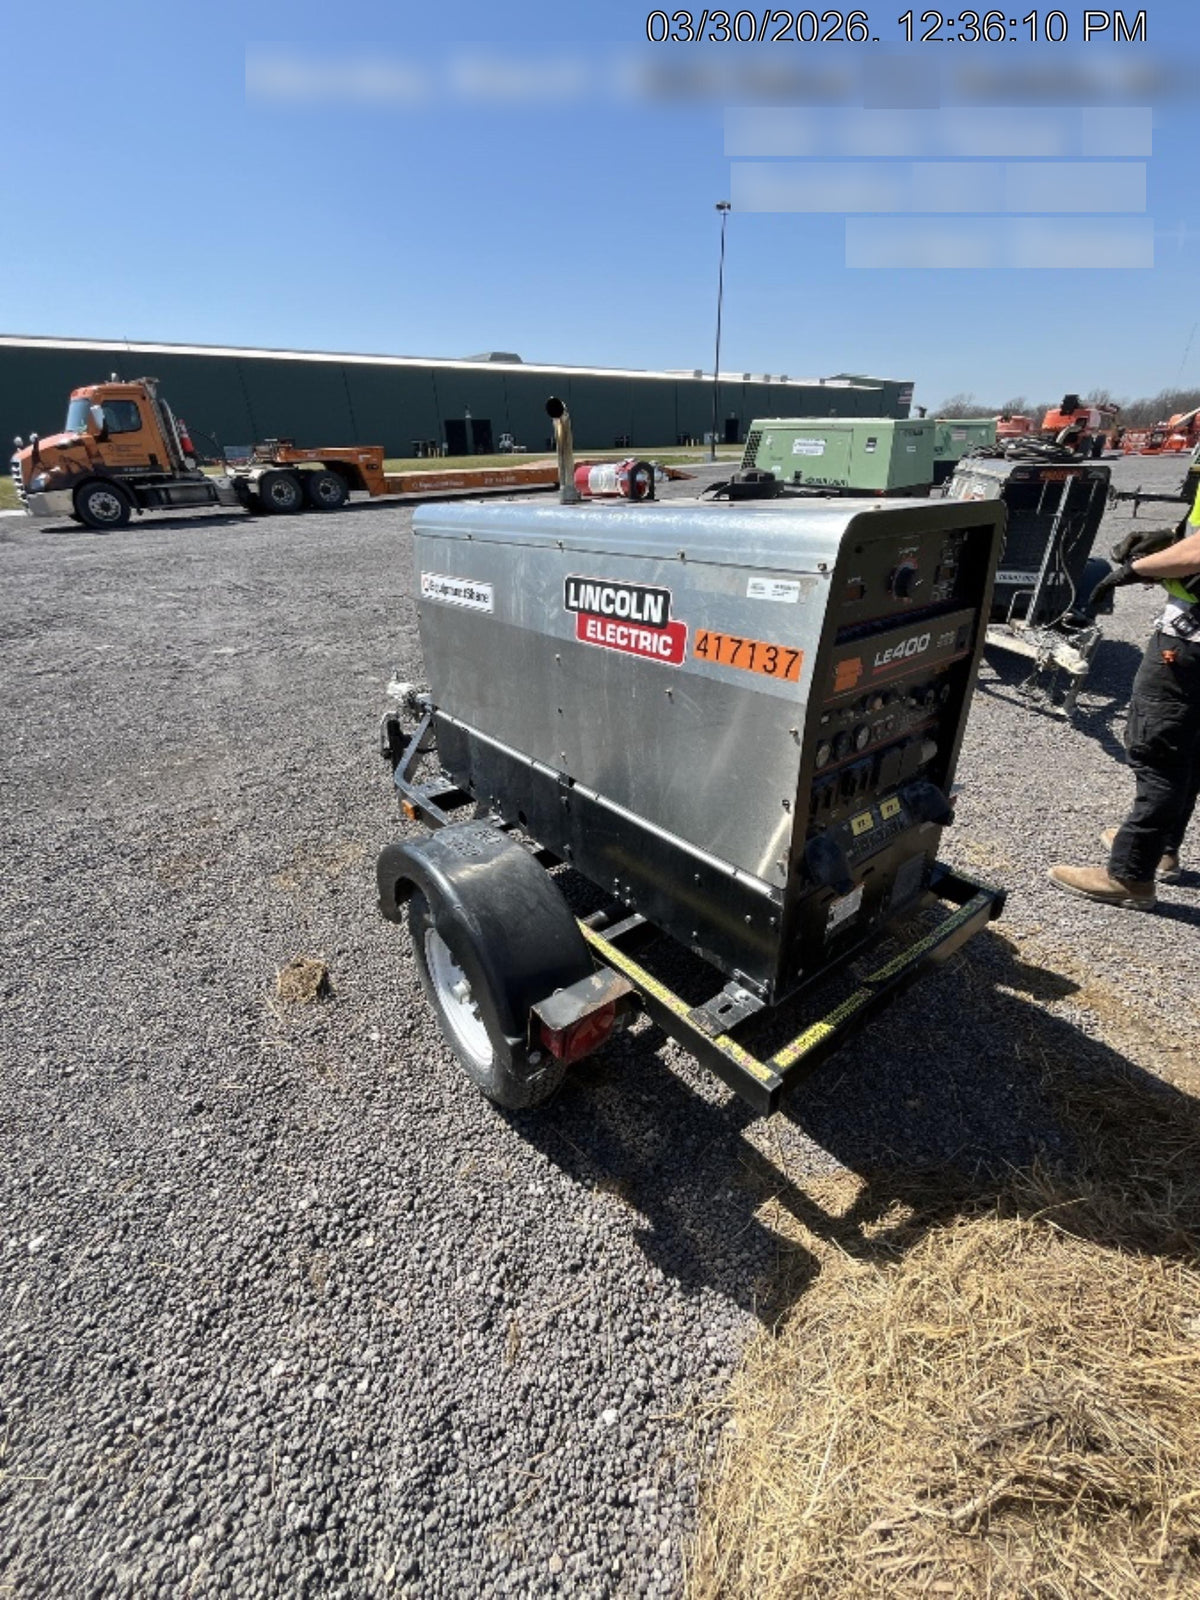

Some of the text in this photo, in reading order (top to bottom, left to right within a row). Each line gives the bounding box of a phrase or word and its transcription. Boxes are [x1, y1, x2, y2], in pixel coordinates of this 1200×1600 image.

[568, 582, 664, 623] LINCOLN
[586, 618, 673, 657] ELECTRIC
[696, 632, 799, 678] 417137
[873, 632, 931, 667] LE400
